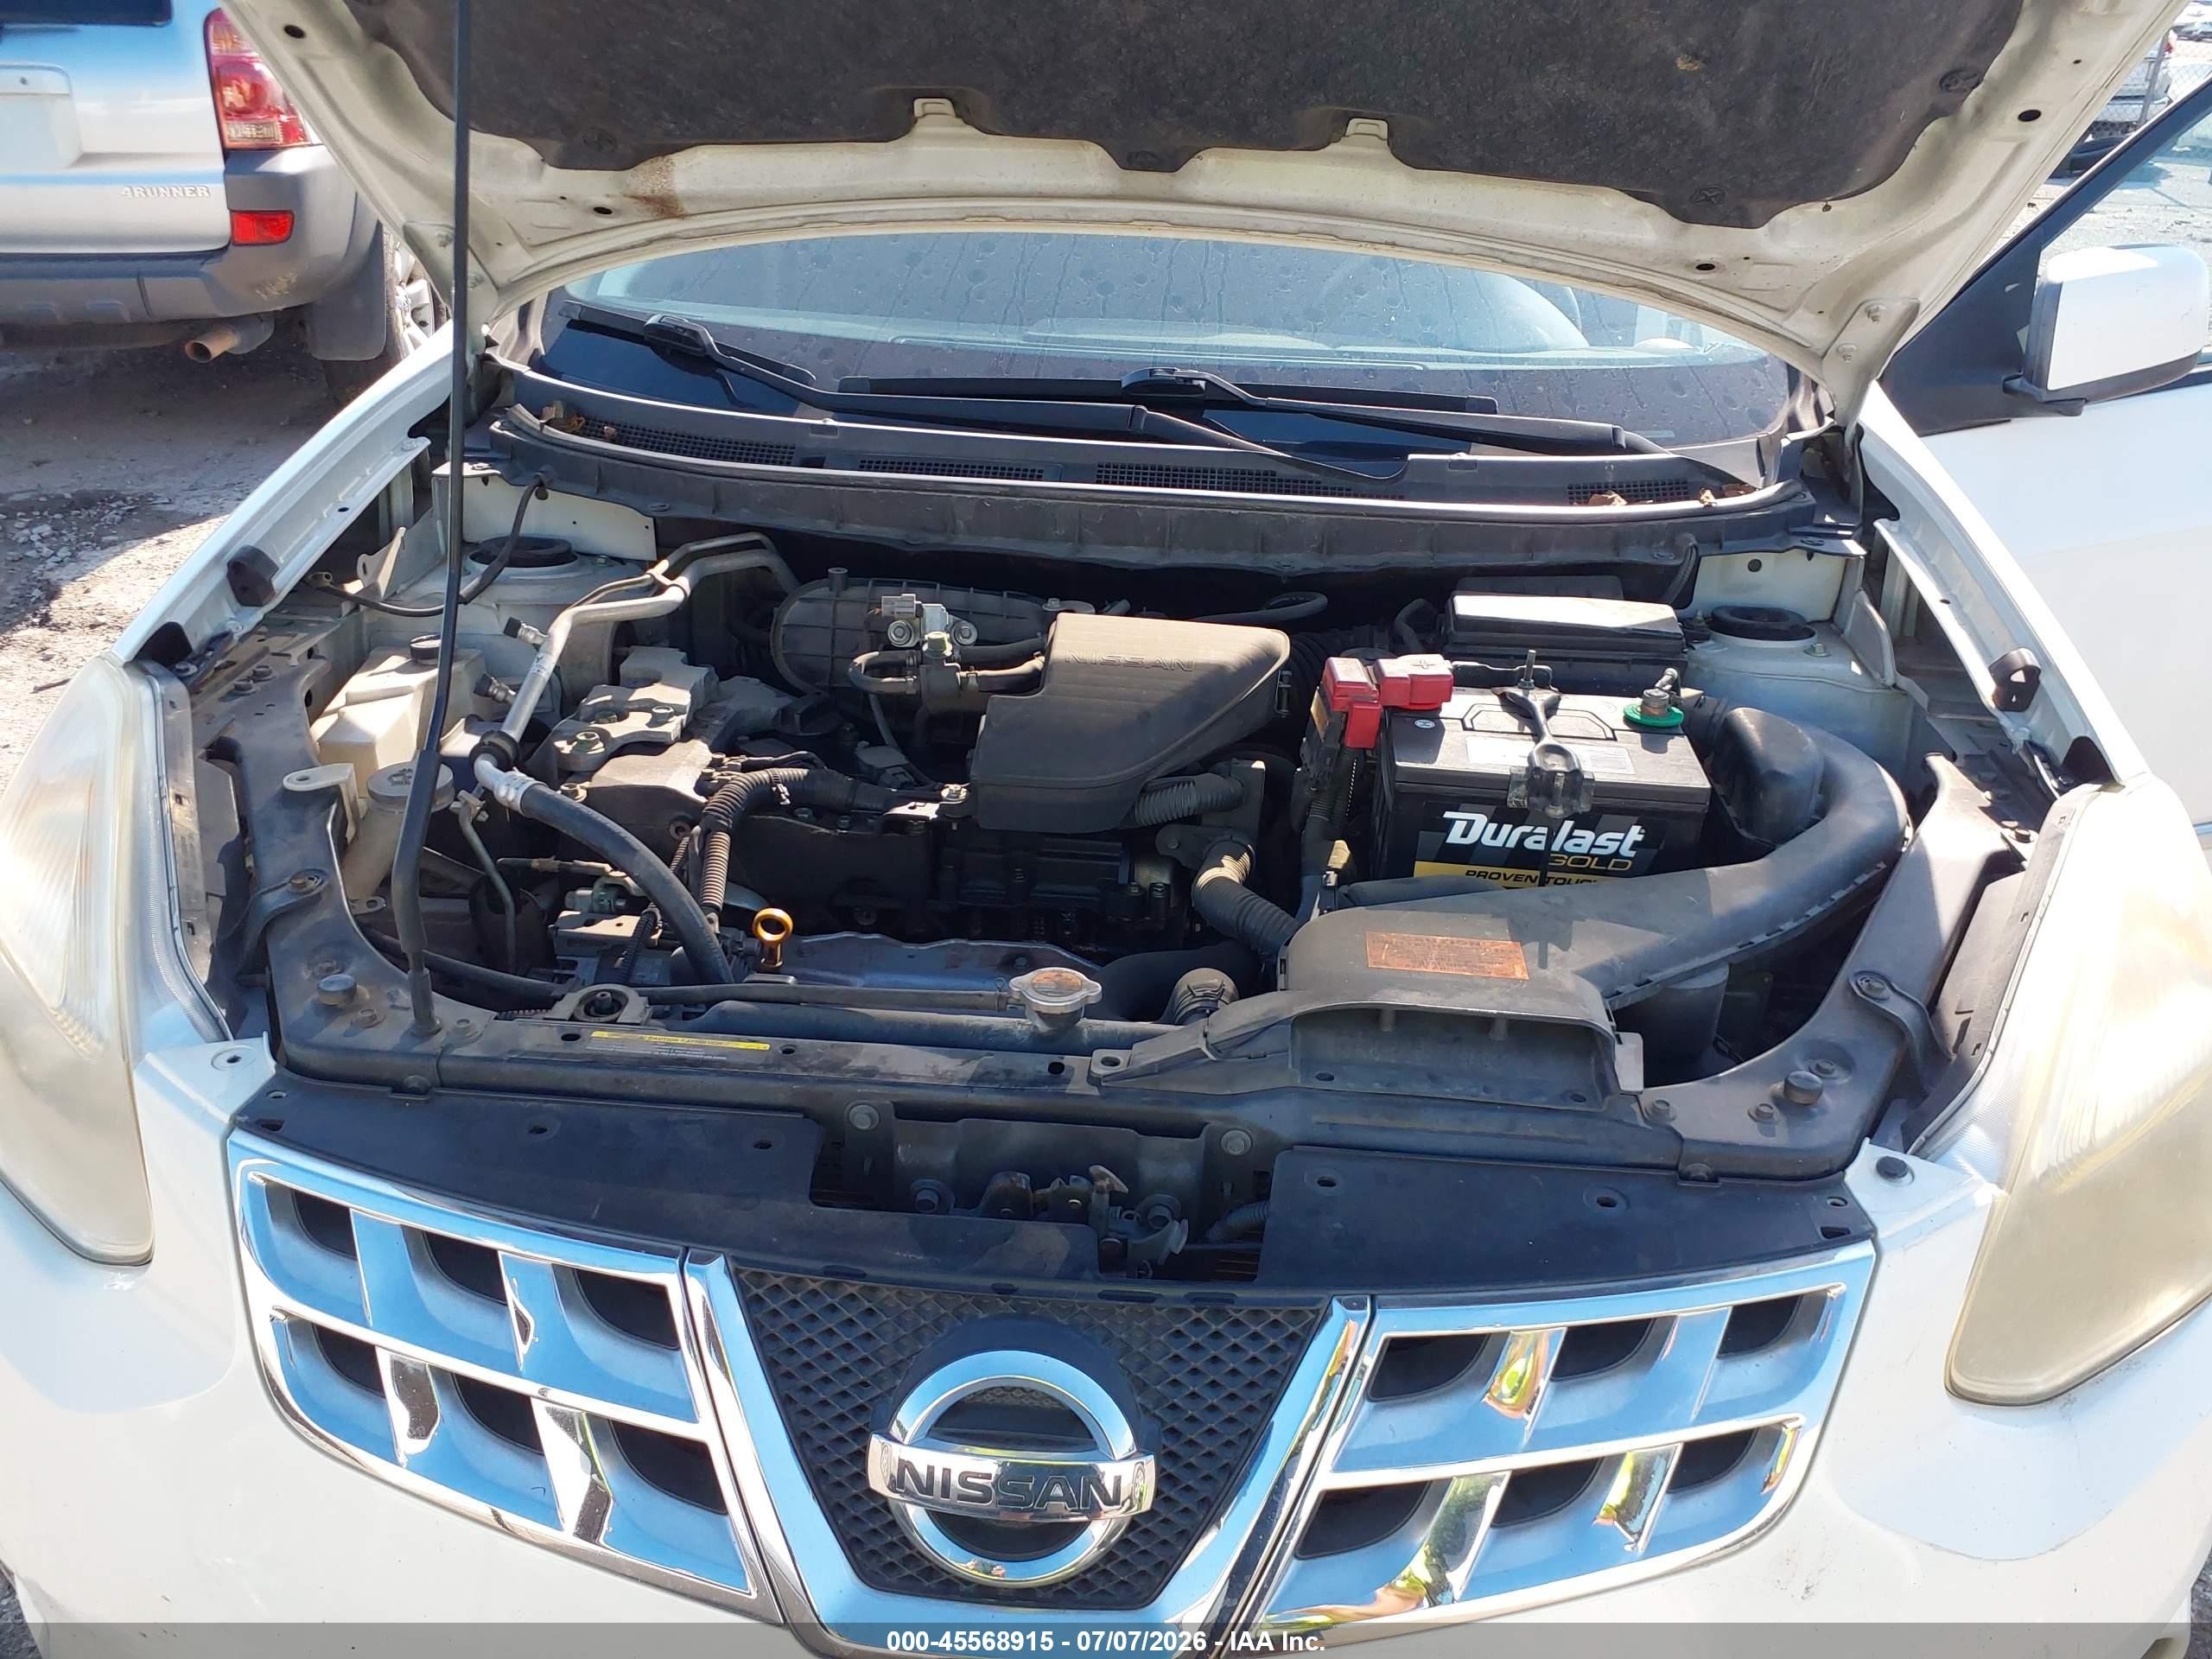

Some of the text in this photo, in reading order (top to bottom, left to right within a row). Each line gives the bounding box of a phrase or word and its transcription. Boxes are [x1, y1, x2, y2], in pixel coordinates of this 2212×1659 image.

[120, 185, 211, 198] 4RUNNER
[1065, 650, 1195, 672] NISSAN
[1442, 810, 1645, 858] Duralast
[1465, 869, 1539, 884] PROVEN
[896, 1457, 1122, 1510] NISSAN
